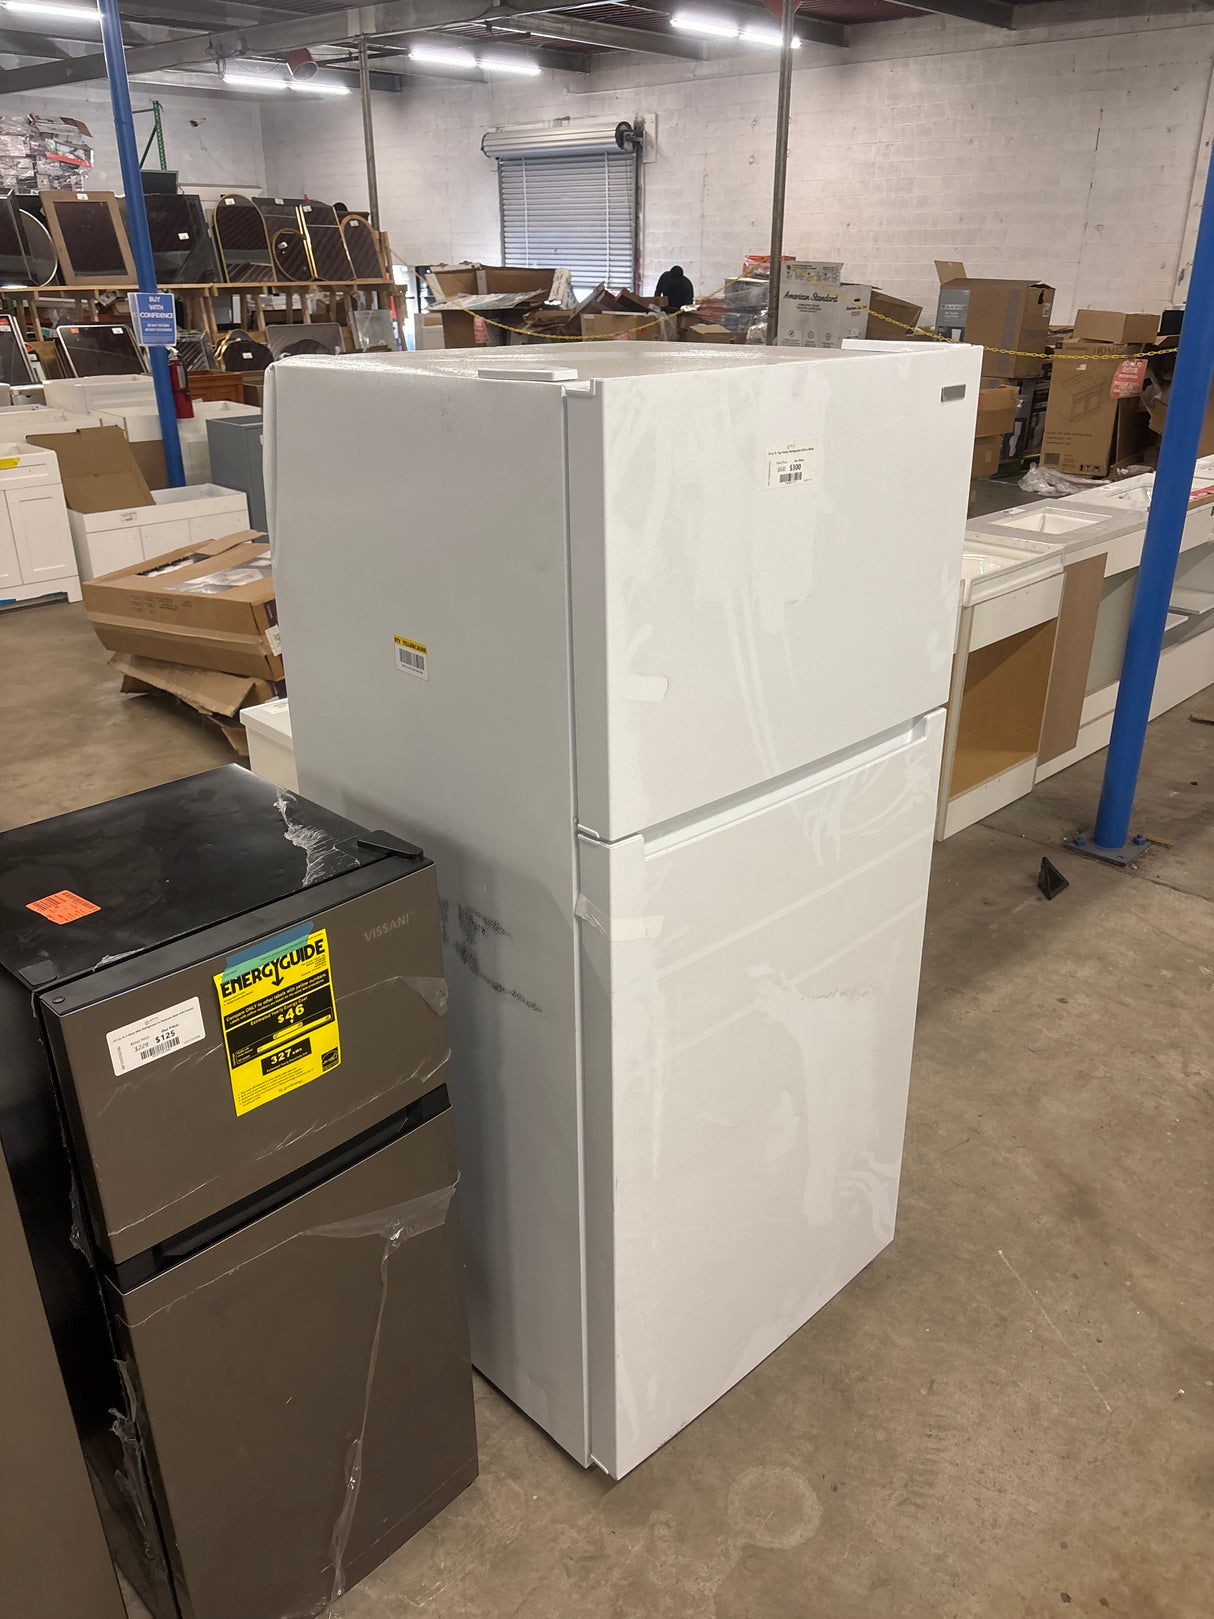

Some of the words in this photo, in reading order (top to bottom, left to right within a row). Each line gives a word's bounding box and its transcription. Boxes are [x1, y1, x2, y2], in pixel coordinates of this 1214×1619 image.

[783, 291, 810, 301] American
[811, 292, 838, 303] Standard
[790, 463, 802, 471] $300
[364, 912, 409, 941] VISSANI
[221, 938, 325, 998] ENERGYGUIDE
[226, 1009, 244, 1022] Compare
[245, 1004, 256, 1013] ONLY
[262, 996, 272, 1005] other
[274, 990, 285, 1000] labels
[286, 986, 295, 994] with
[295, 980, 308, 990] yellow
[250, 1012, 270, 1026] Estimated
[271, 1007, 282, 1016] Yearly
[283, 1000, 297, 1010] Energy
[298, 995, 307, 1003] Cost
[277, 1004, 304, 1023] $46
[134, 1041, 149, 1052] $229
[155, 1030, 176, 1043] $125
[271, 1049, 292, 1064] 327
